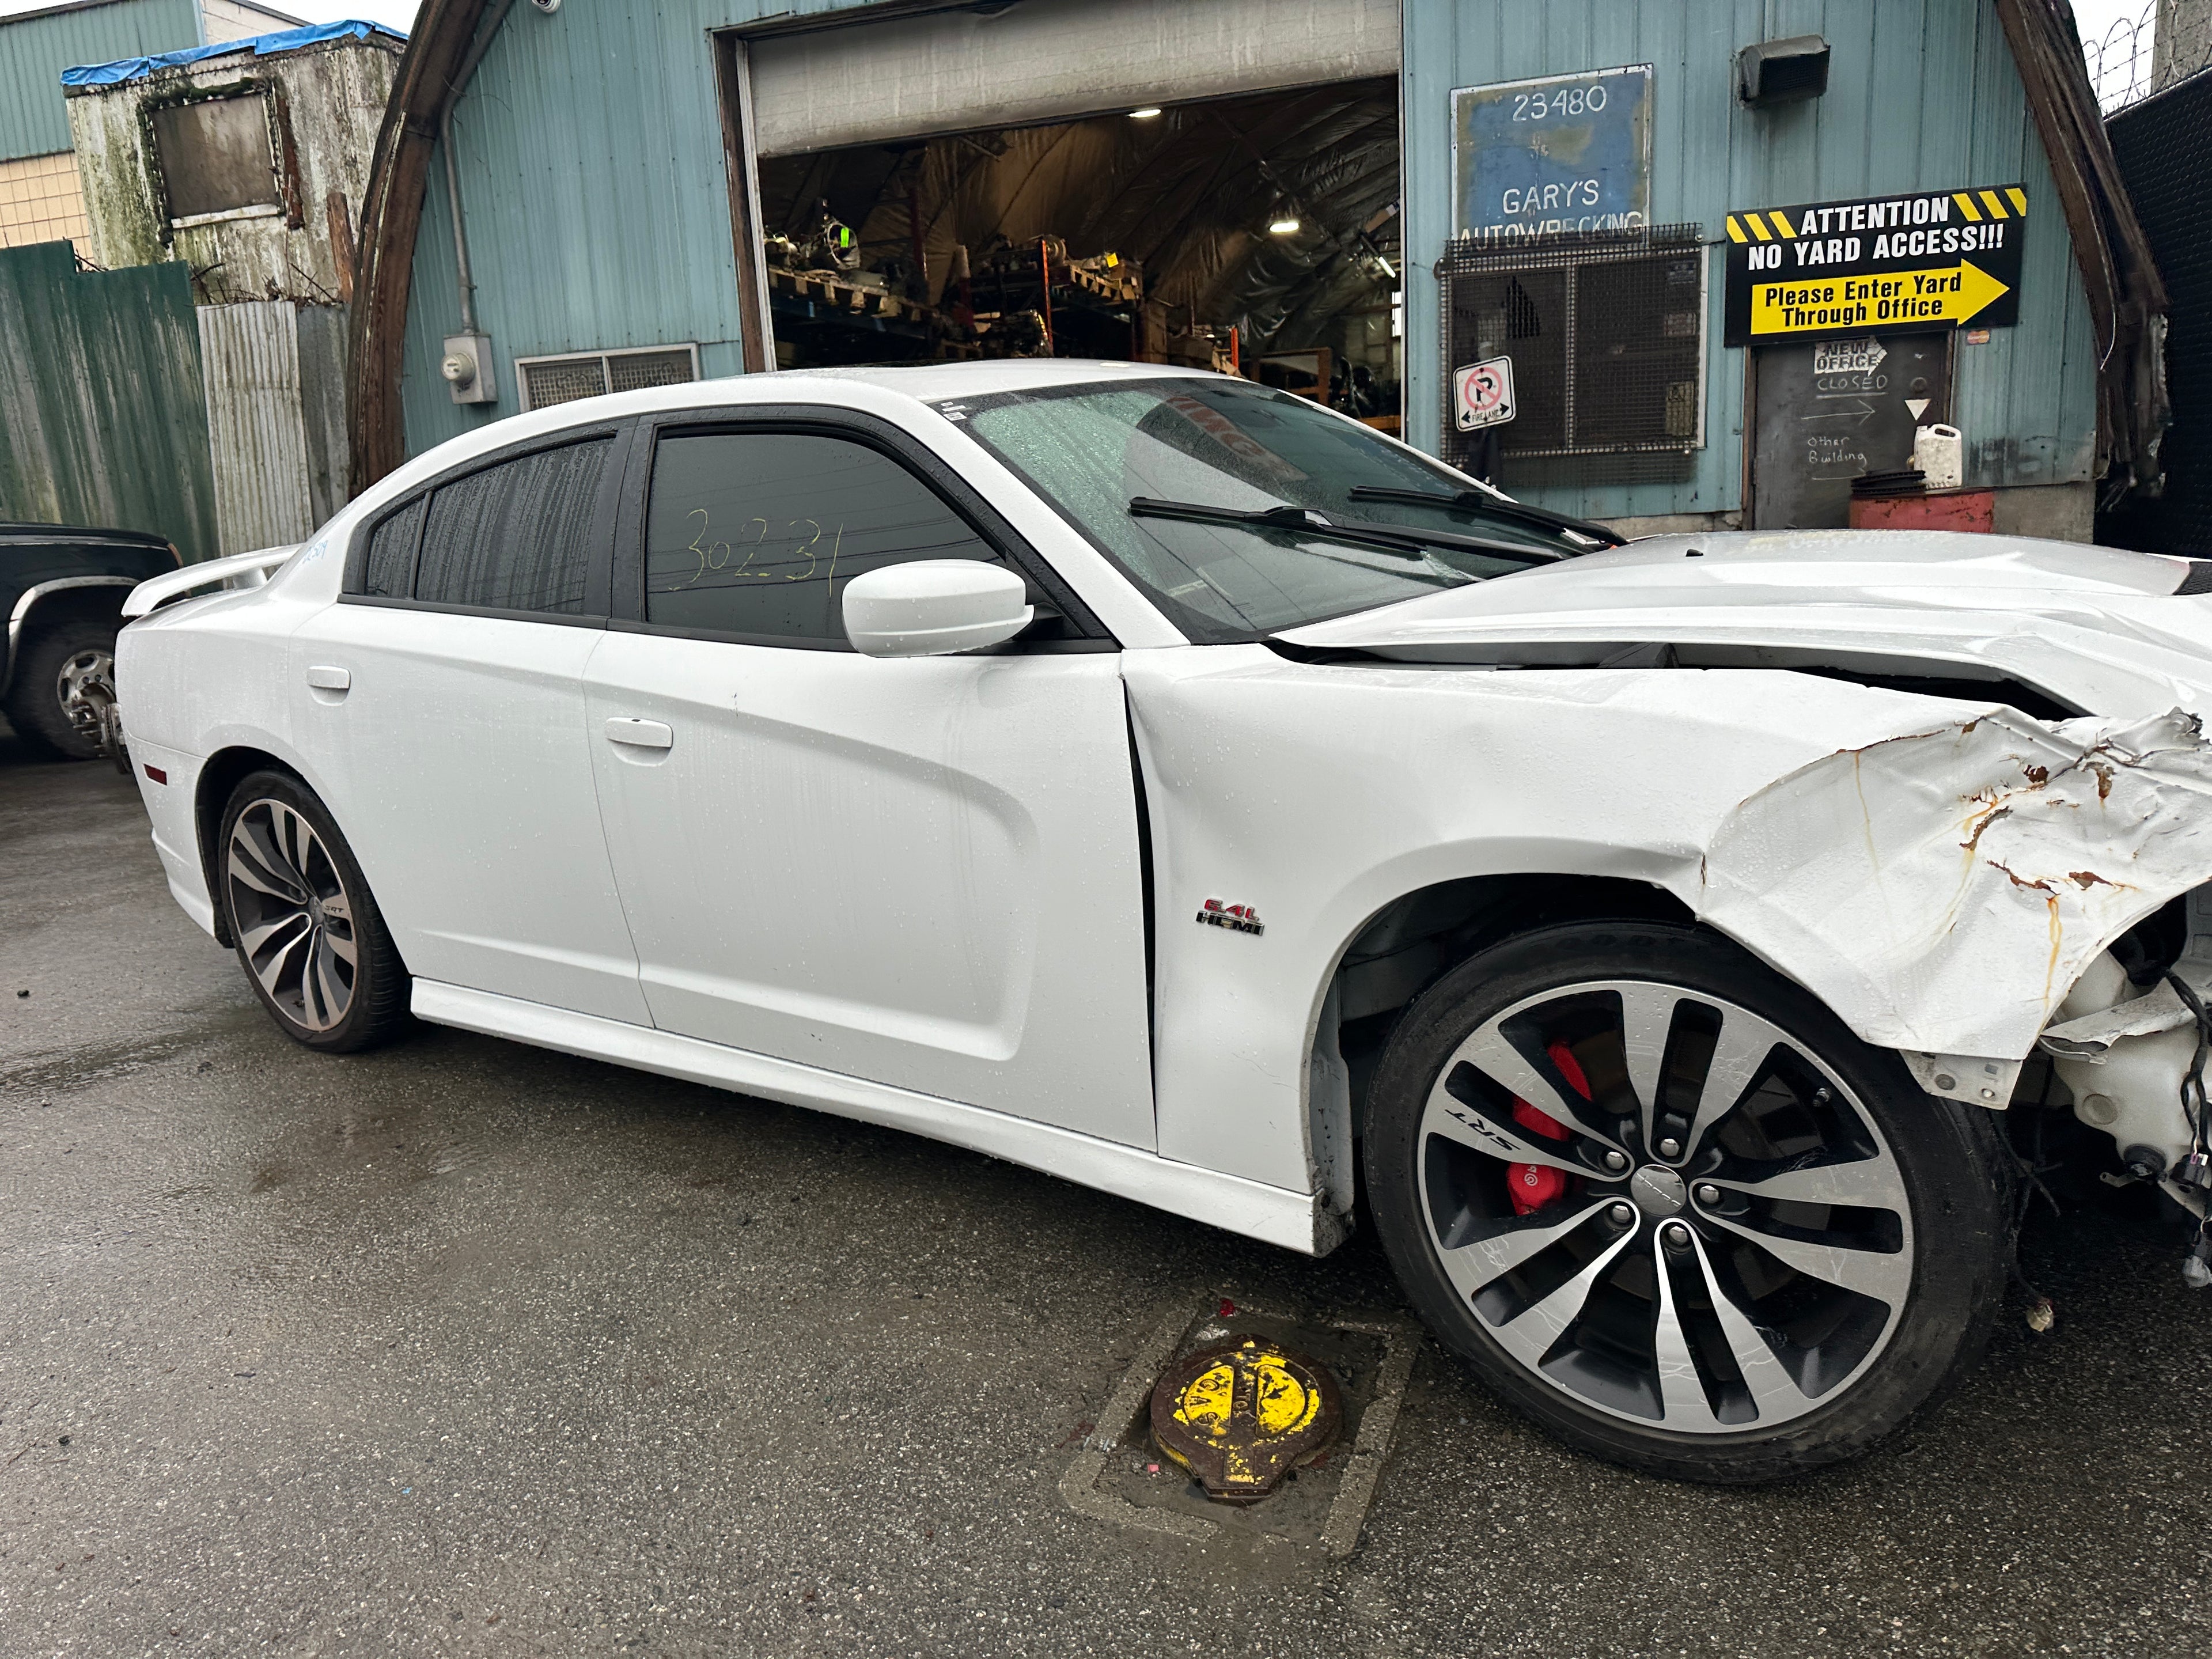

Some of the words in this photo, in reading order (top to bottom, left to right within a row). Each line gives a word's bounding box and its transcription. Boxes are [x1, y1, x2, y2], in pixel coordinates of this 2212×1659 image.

[1513, 85, 1607, 122] 23480
[1503, 179, 1599, 214] GARY'S
[1801, 196, 1949, 235] ATTENTION
[1748, 244, 1782, 271] NO
[1794, 236, 1861, 266] YARD
[1873, 223, 2004, 259] ACCESS!!!
[1765, 285, 1834, 307] Please
[1844, 281, 1903, 301] Enter
[1913, 272, 1961, 294] Yard
[1782, 303, 1866, 327] Through
[1877, 298, 1942, 319] Office
[1817, 375, 1888, 391] CLOSED
[1808, 436, 1849, 446] Other
[1809, 449, 1868, 468] Building
[1204, 898, 1260, 922] 6.4L
[1445, 1109, 1521, 1150] SRT
